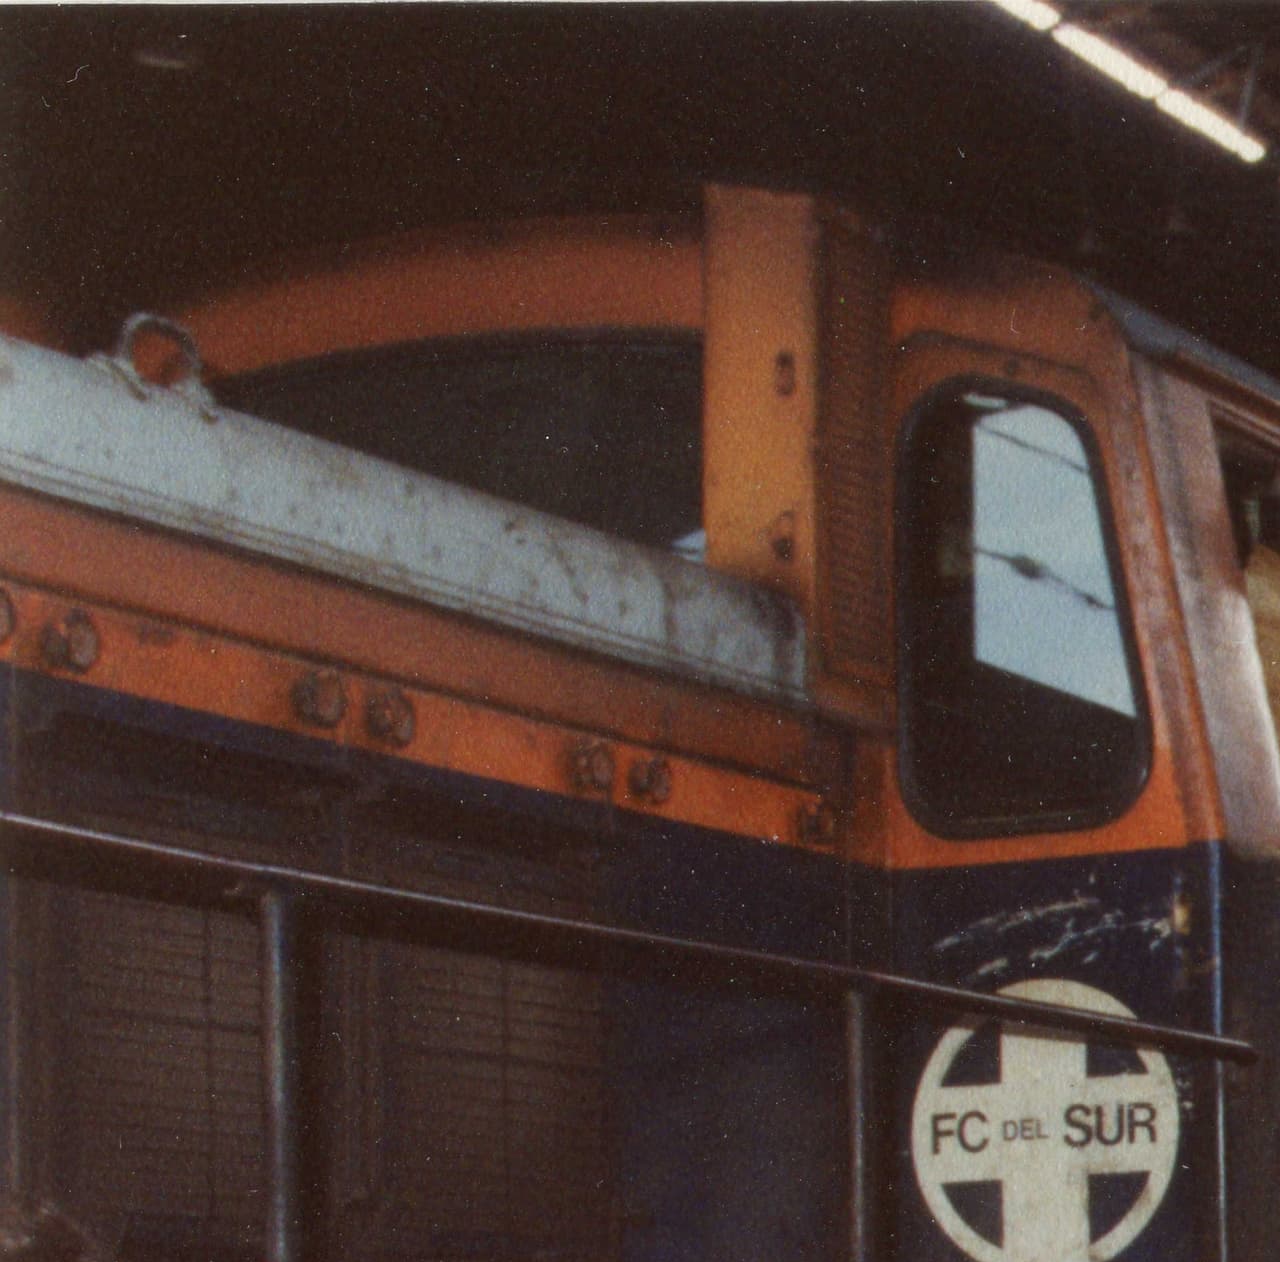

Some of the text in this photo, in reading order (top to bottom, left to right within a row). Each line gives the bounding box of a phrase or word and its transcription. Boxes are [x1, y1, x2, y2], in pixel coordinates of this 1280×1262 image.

[930, 1102, 1157, 1155] FC DEL SUR
